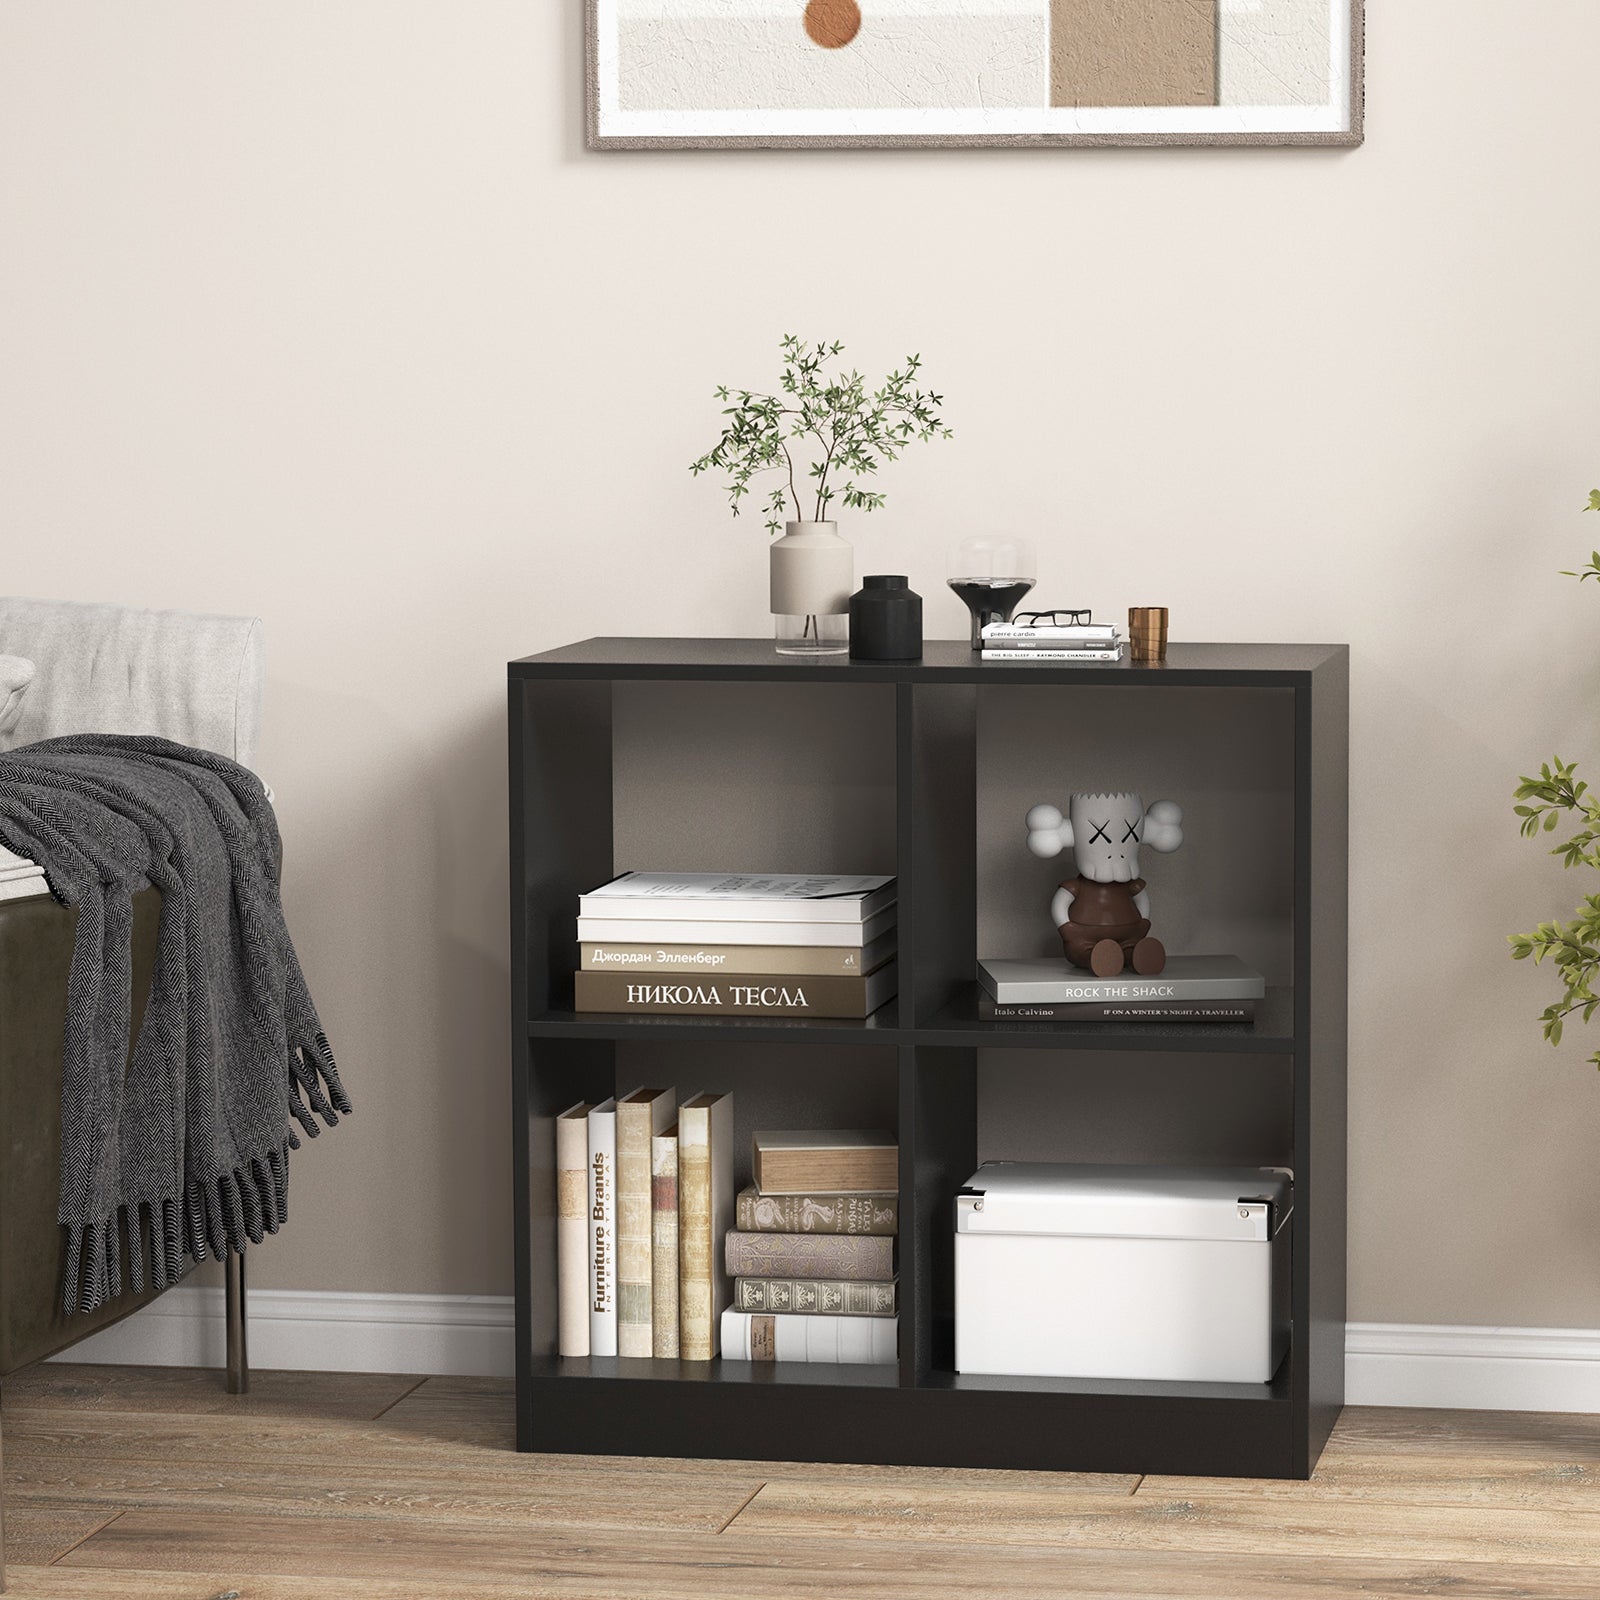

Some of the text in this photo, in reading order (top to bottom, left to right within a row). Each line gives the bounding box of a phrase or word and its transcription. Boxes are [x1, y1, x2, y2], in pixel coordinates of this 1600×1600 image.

[592, 949, 726, 965] Джордан Элленберг
[626, 984, 809, 1007] НИКОЛА ТЕСЛА
[1065, 986, 1175, 998] ROCK THE SHACK
[994, 1008, 1054, 1016] Italo Calvino
[863, 1199, 873, 1232] TALES
[592, 1151, 605, 1313] Furniture Brands
